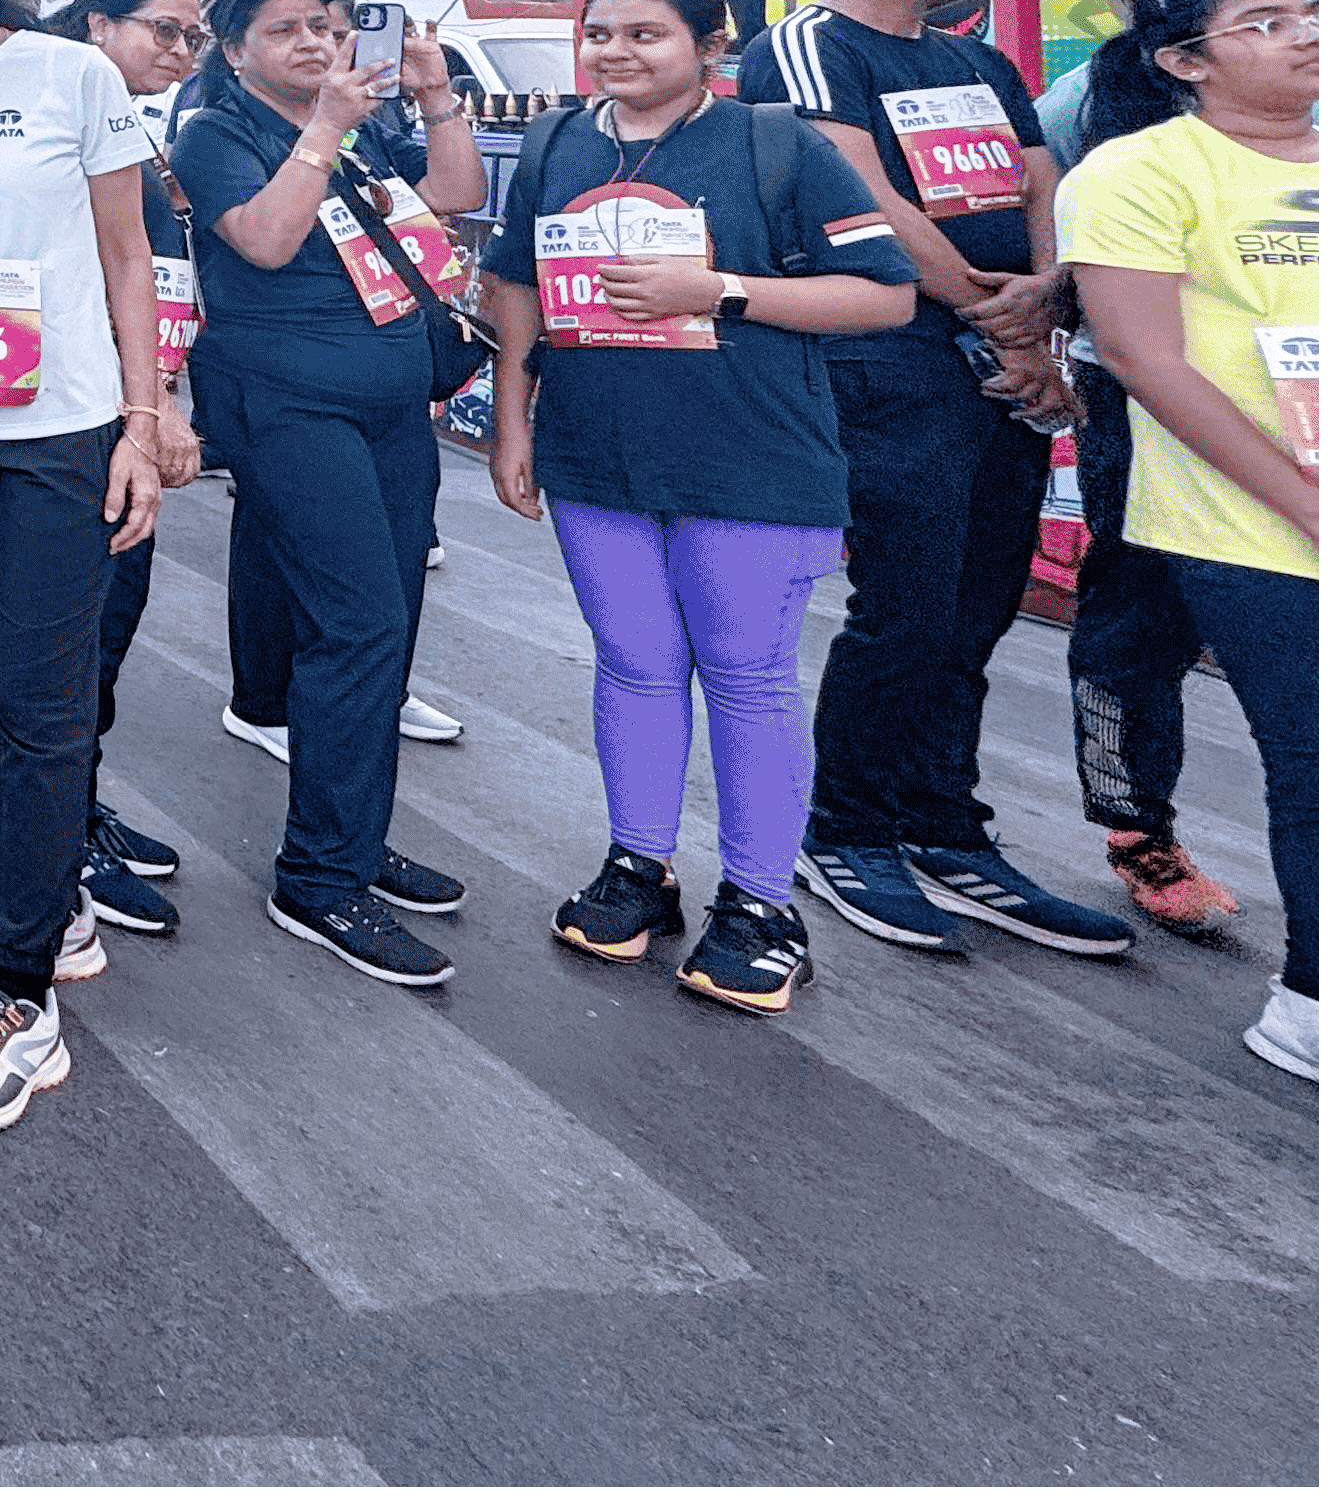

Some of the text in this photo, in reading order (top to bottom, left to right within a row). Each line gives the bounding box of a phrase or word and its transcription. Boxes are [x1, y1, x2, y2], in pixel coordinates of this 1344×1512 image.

[108, 115, 135, 133] tcs
[898, 117, 931, 128] TATA
[933, 140, 1012, 174] 96610
[333, 223, 359, 237] TATA
[541, 240, 599, 253] TATA tcs
[1240, 253, 1319, 266] PERF
